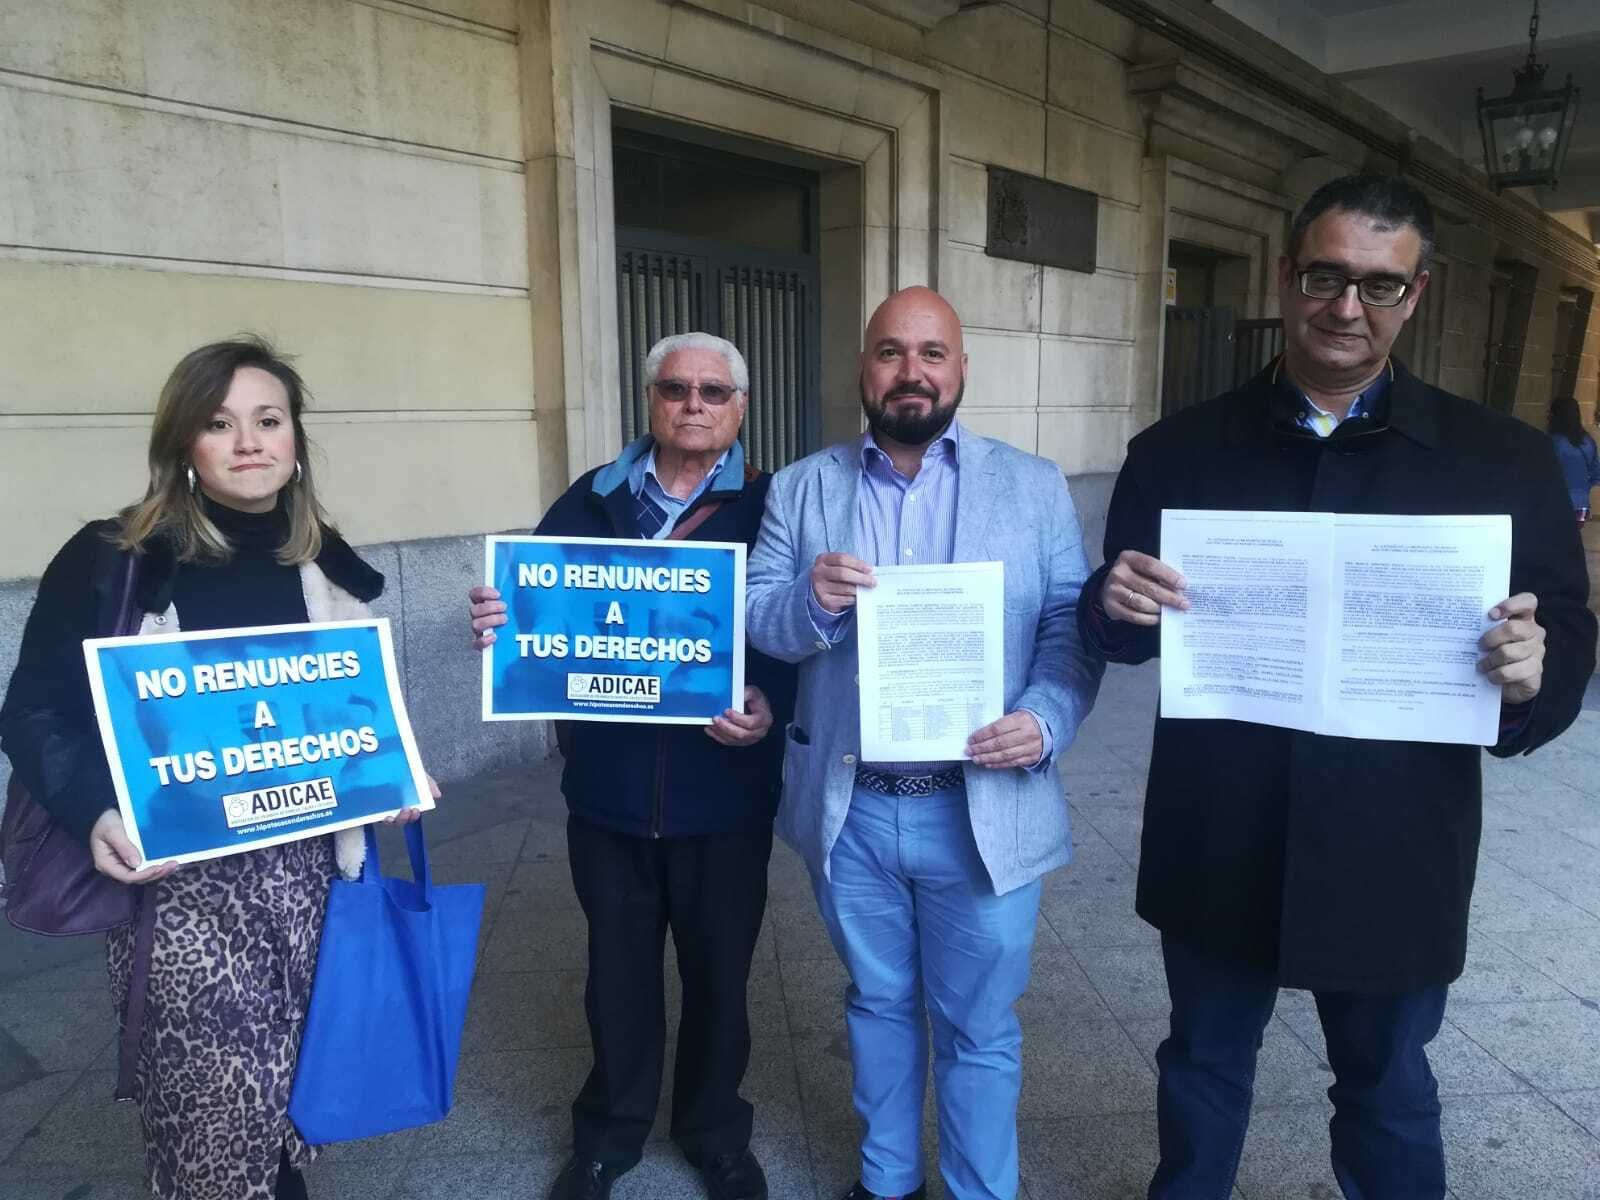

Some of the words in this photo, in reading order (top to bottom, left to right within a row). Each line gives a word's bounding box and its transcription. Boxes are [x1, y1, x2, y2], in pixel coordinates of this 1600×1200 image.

[518, 563, 558, 587] NO
[564, 564, 711, 592] RENUNCIES
[604, 601, 624, 625] A
[516, 634, 568, 658] TUS
[574, 635, 712, 663] DERECHOS
[136, 668, 186, 701] NO
[193, 651, 361, 693] RENUNCIES
[589, 677, 658, 695] ADICAE
[254, 701, 276, 729] A
[150, 750, 217, 786] TUS
[223, 726, 379, 776] DERECHOS
[252, 780, 333, 815] ADICAE
